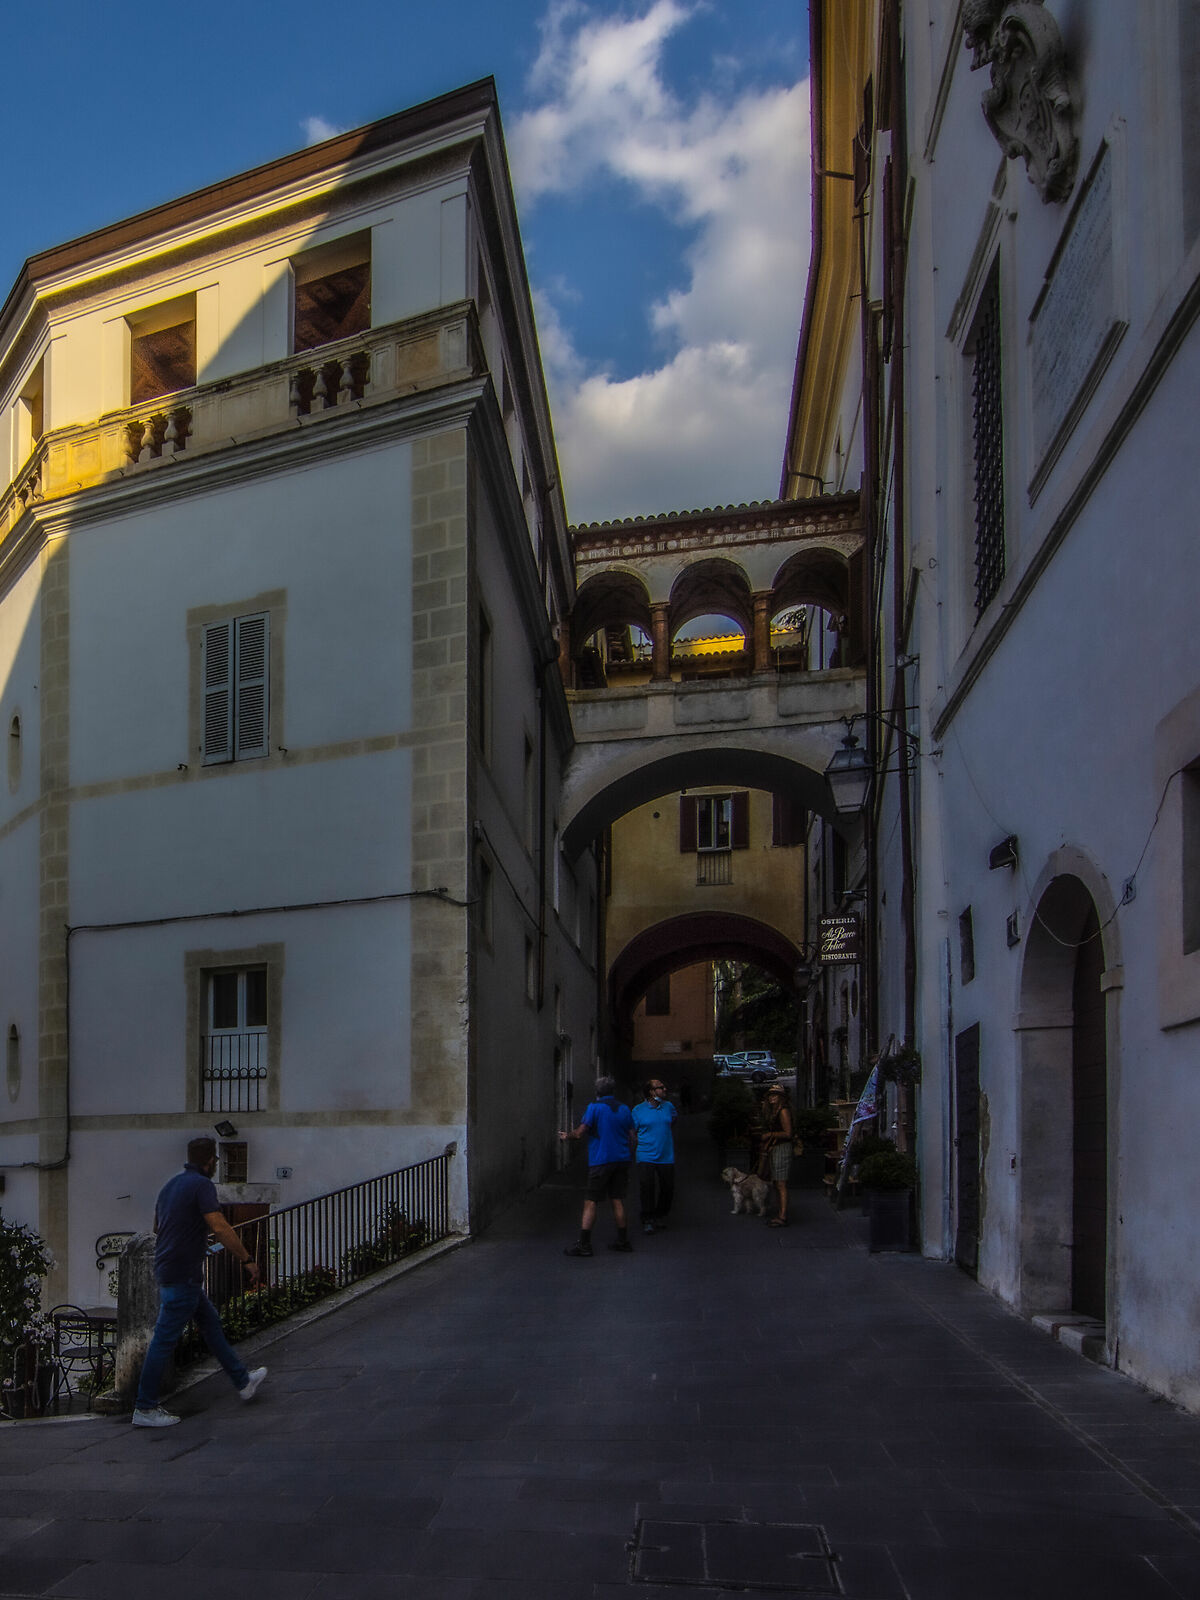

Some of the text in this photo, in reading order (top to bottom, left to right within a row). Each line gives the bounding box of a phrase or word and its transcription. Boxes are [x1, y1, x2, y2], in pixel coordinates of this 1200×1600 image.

[821, 917, 856, 925] OSTERIA
[834, 926, 856, 940] Bacco
[821, 937, 846, 952] Felice
[821, 952, 857, 961] RISTORANTE
